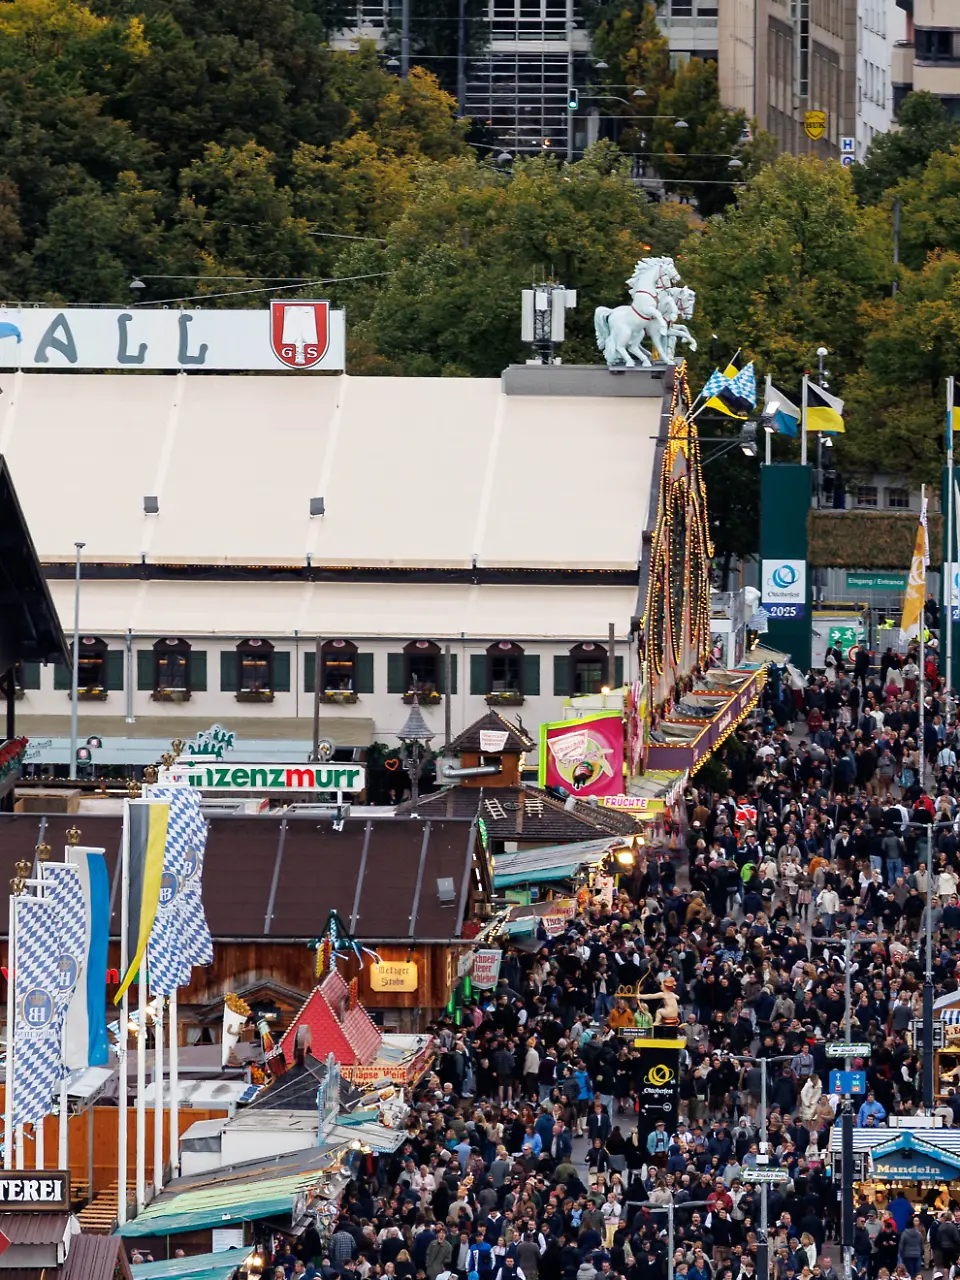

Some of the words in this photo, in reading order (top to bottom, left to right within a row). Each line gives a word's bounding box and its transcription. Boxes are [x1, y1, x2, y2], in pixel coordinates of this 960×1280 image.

[848, 577, 873, 587] Eingang
[878, 578, 905, 586] Entrance
[770, 606, 797, 617] 2025
[604, 795, 648, 808] FRÜCHTE
[876, 1164, 941, 1174] Mandeln
